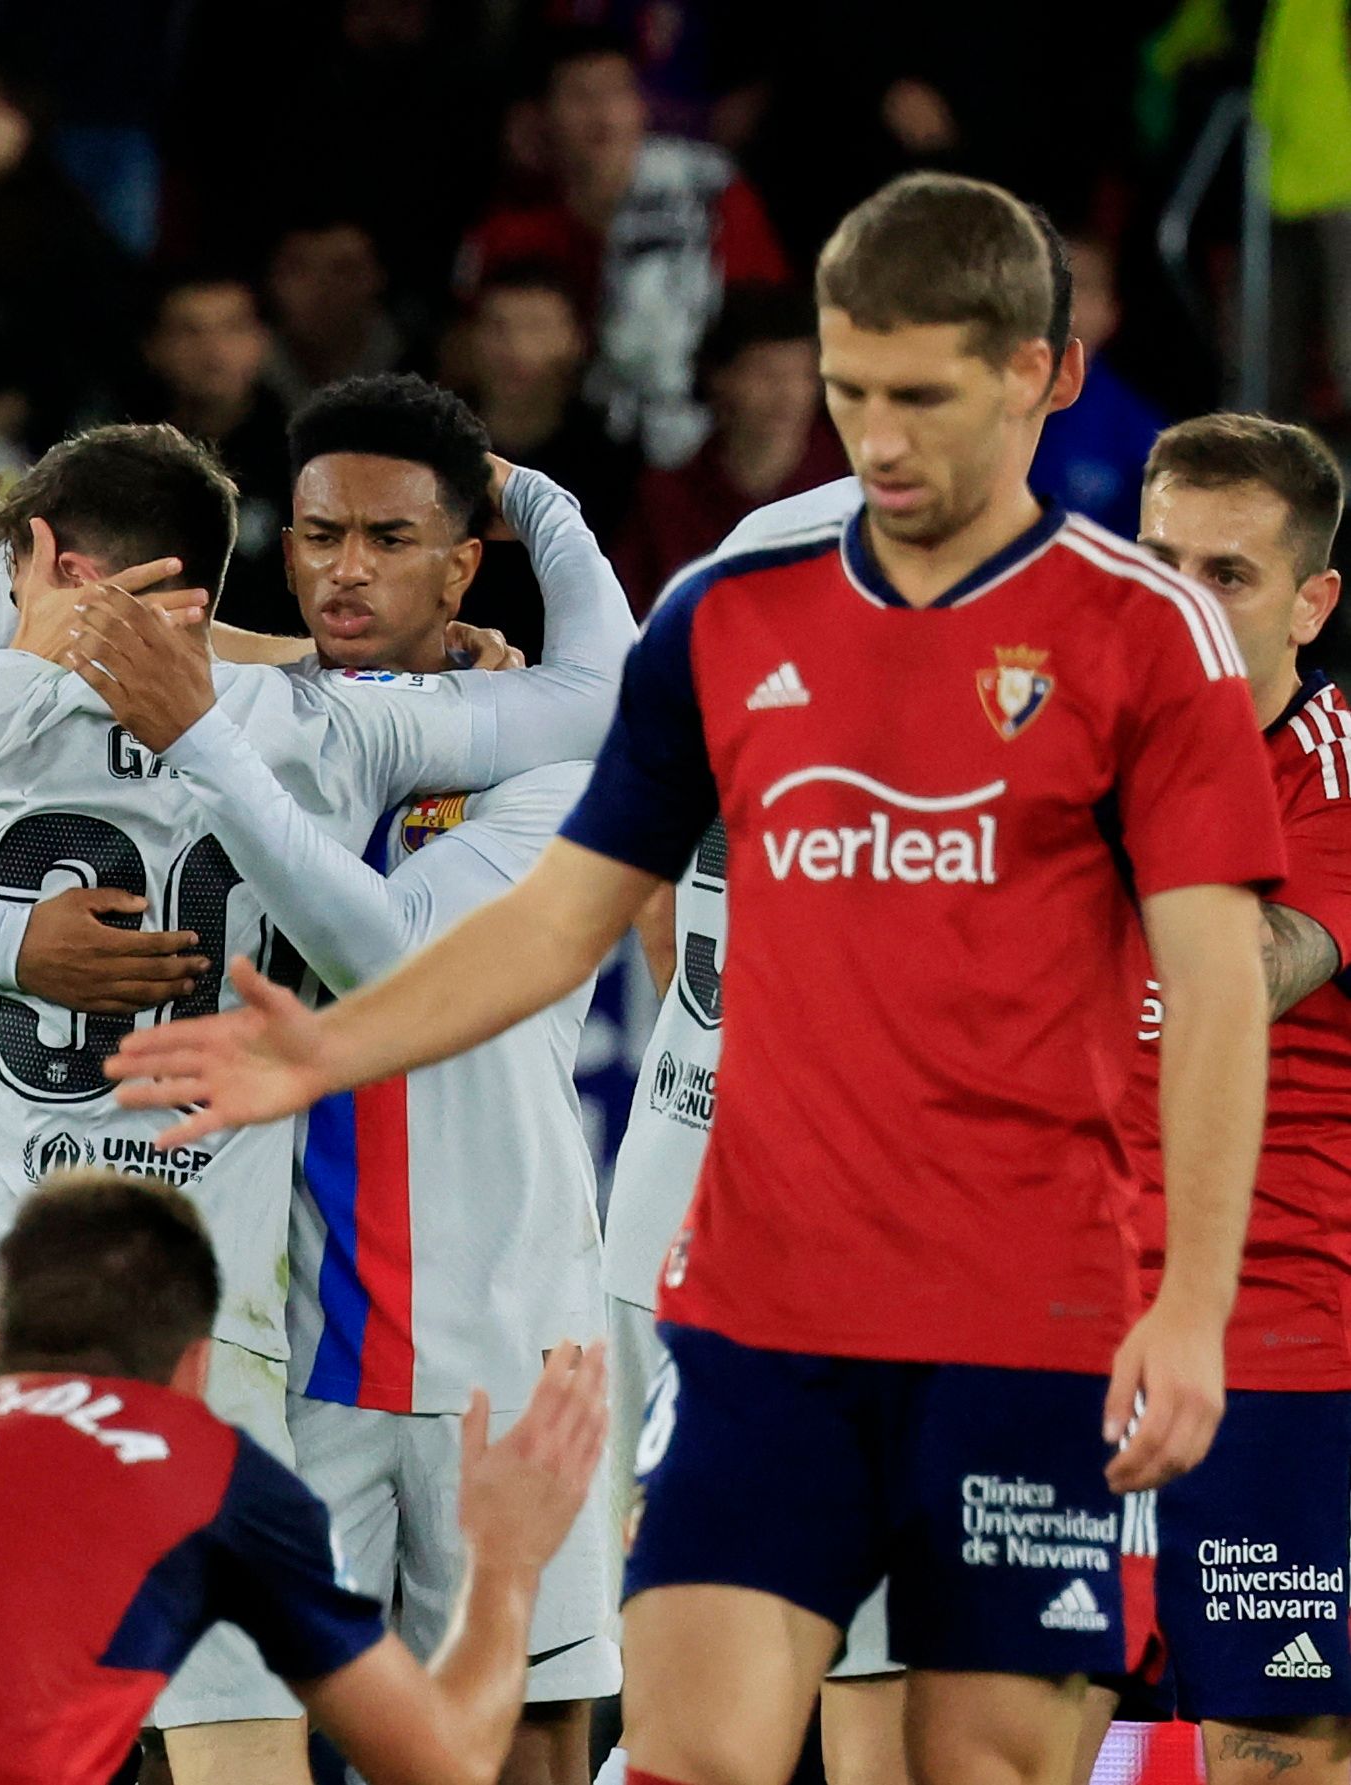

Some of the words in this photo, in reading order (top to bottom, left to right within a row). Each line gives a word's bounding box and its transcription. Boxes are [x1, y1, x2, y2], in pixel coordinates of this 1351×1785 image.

[762, 811, 997, 884] verleal
[963, 1504, 1118, 1543] Universidad
[962, 1535, 998, 1566] de
[1006, 1535, 1110, 1573] Navarra
[1198, 1537, 1278, 1566] Clínica
[1201, 1564, 1344, 1594] Universidad
[1205, 1595, 1231, 1622] de
[1236, 1593, 1337, 1621] Navarra
[1264, 1658, 1332, 1679] adidas
